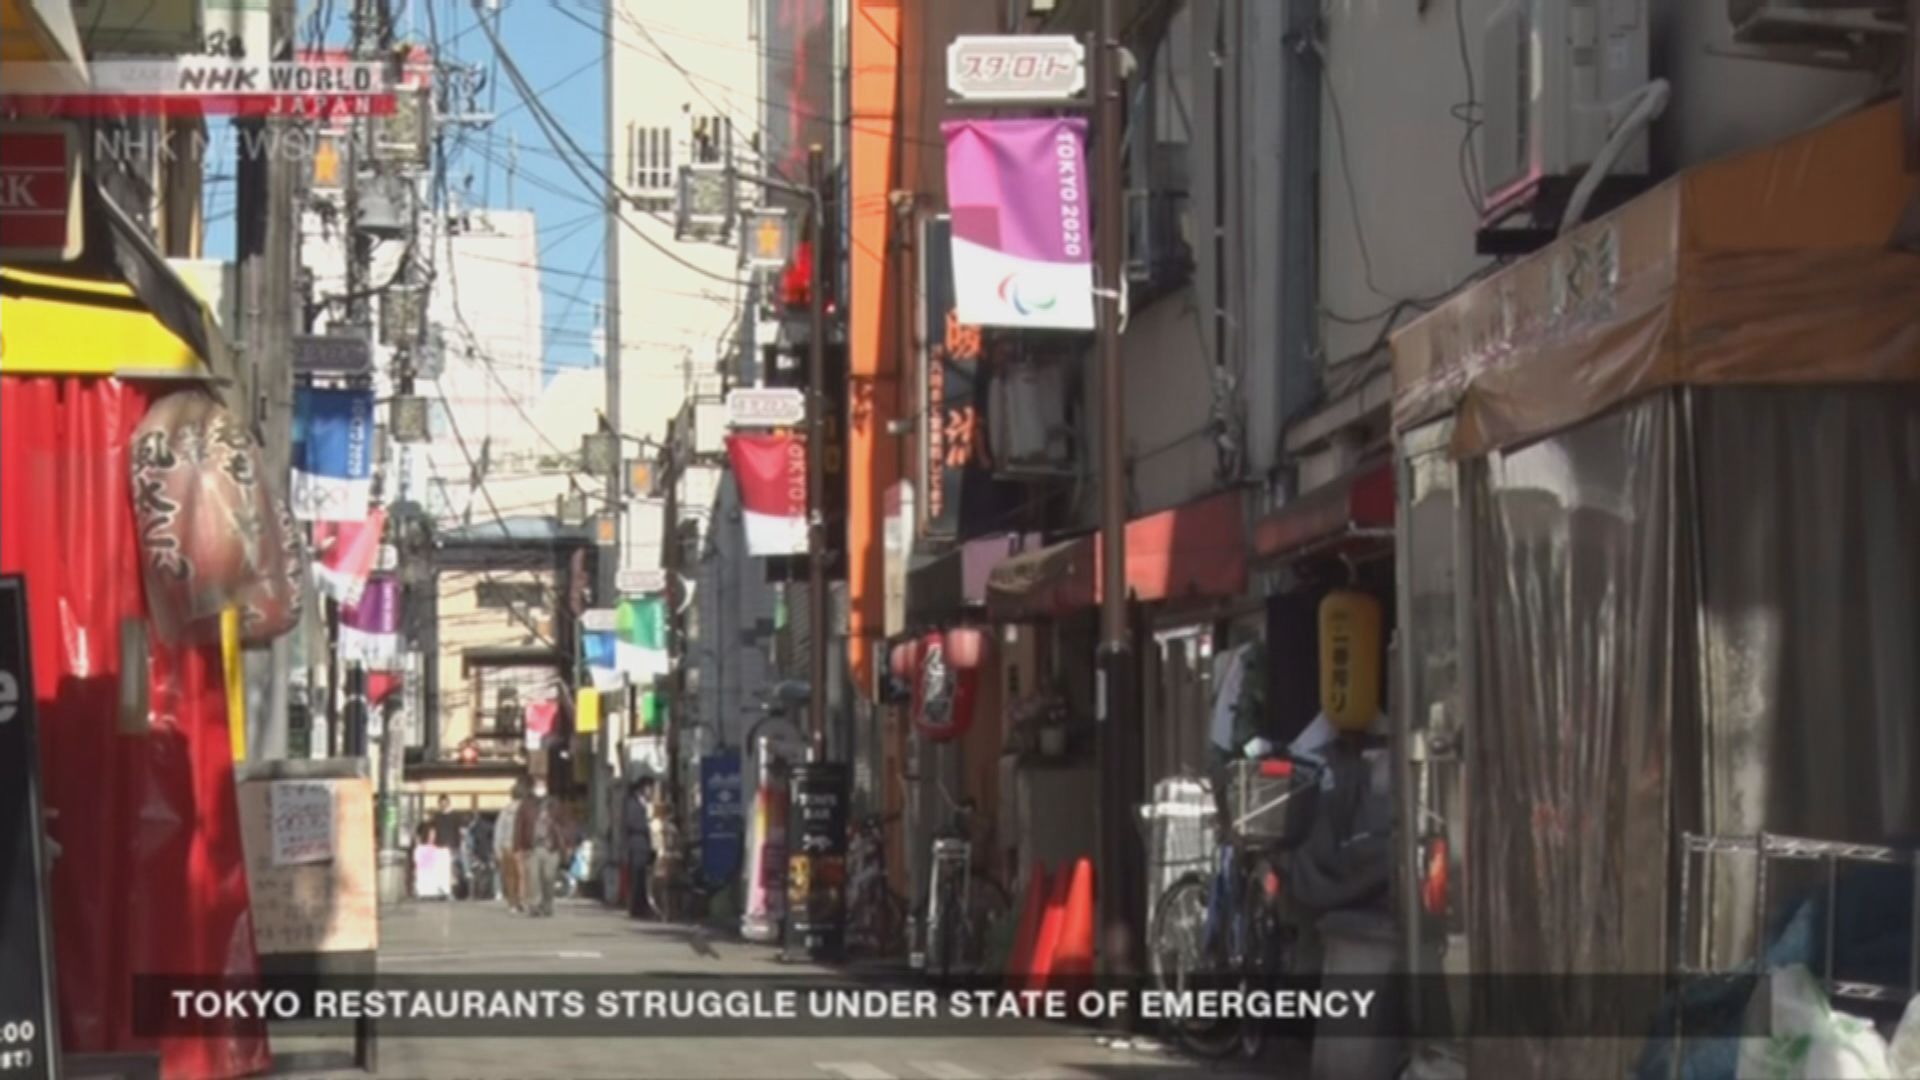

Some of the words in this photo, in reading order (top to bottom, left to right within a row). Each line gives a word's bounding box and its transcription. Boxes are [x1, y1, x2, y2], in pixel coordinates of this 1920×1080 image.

[0, 174, 37, 207] K
[1056, 131, 1079, 202] TOKYO
[1060, 204, 1082, 257] 2020
[788, 430, 807, 499] TOKYO
